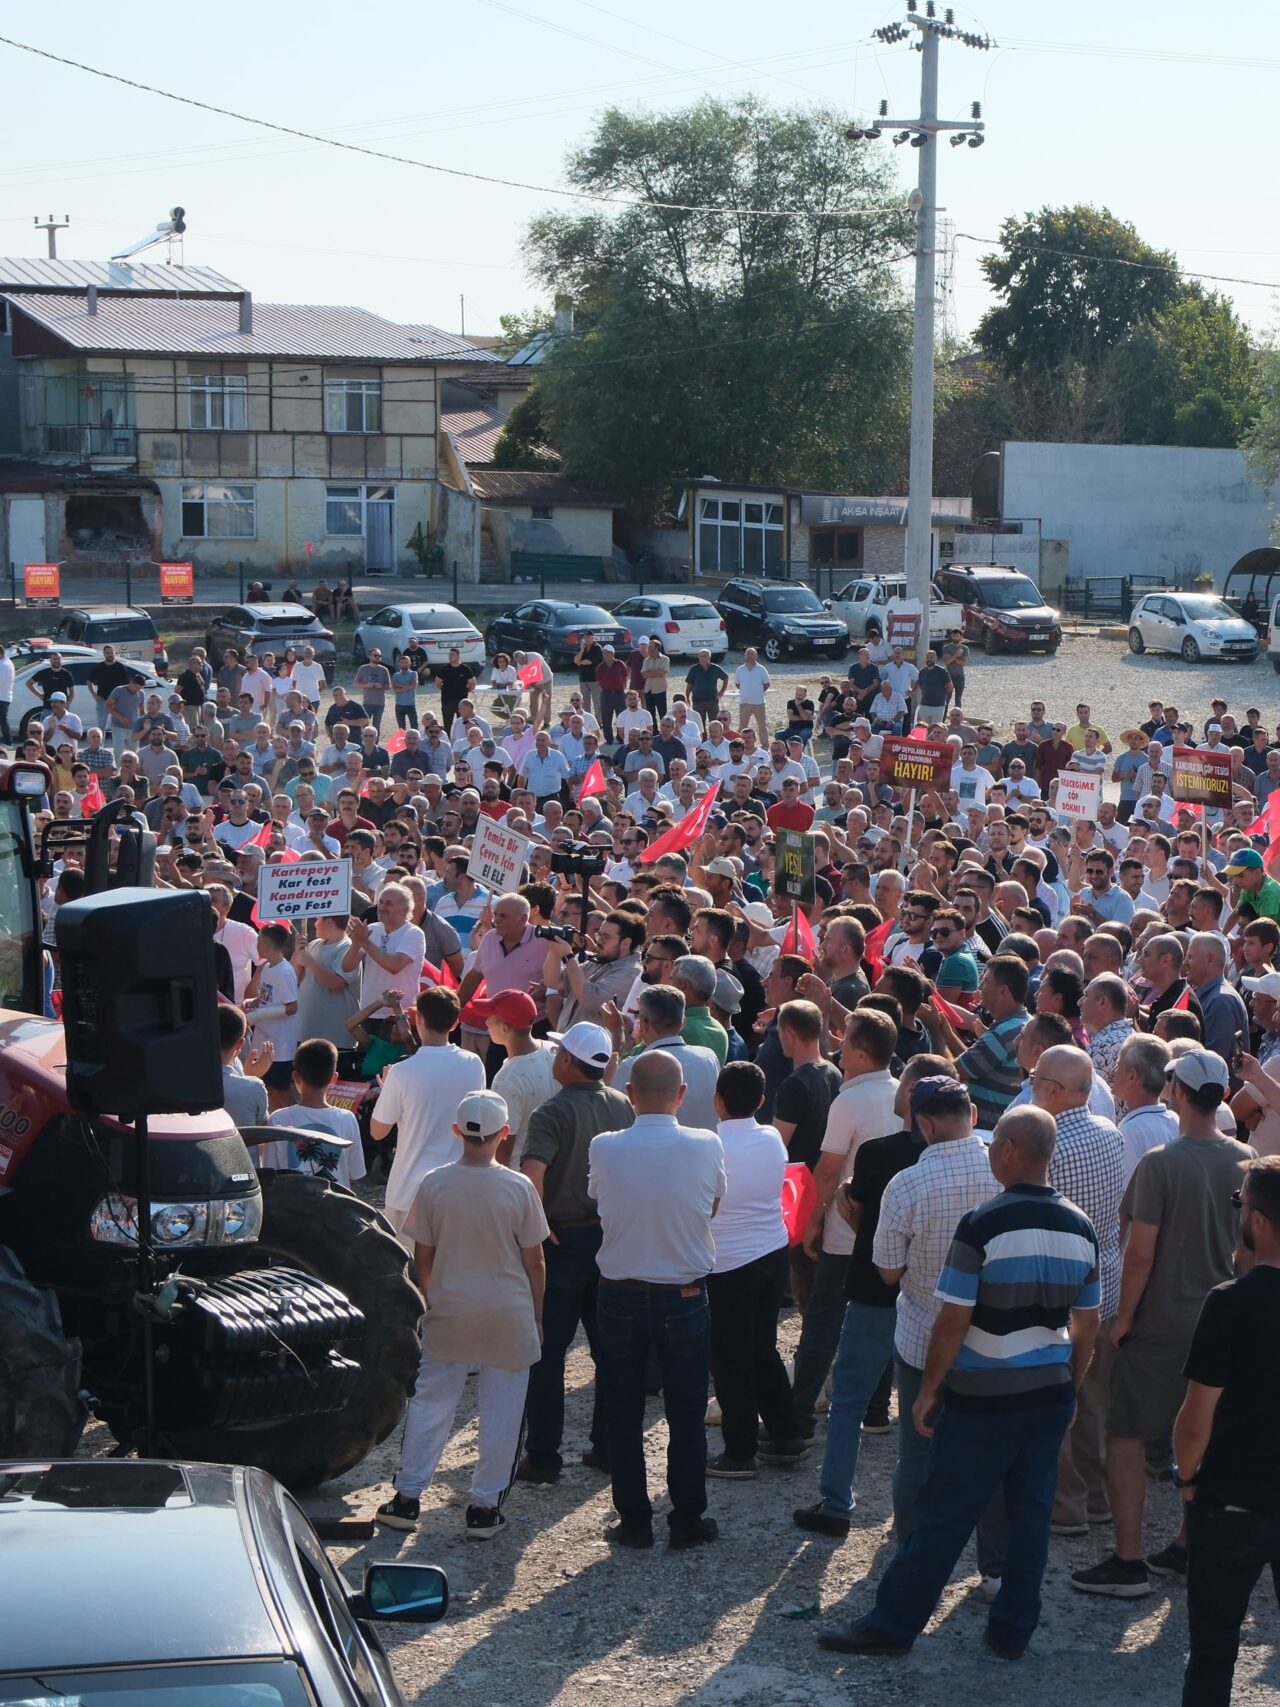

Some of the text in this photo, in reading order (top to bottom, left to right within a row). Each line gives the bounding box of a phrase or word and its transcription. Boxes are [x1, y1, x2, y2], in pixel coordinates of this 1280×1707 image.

[893, 761, 934, 782] HAYIR!
[1176, 771, 1229, 793] İSTEMİYORUZ!
[483, 826, 520, 854] Temiz Bir
[479, 843, 500, 864] Çevre
[270, 865, 339, 878] Kartepeye
[278, 876, 332, 889] Kar fest
[269, 889, 339, 902] Kandıraya
[276, 900, 332, 915] Çöp Fest
